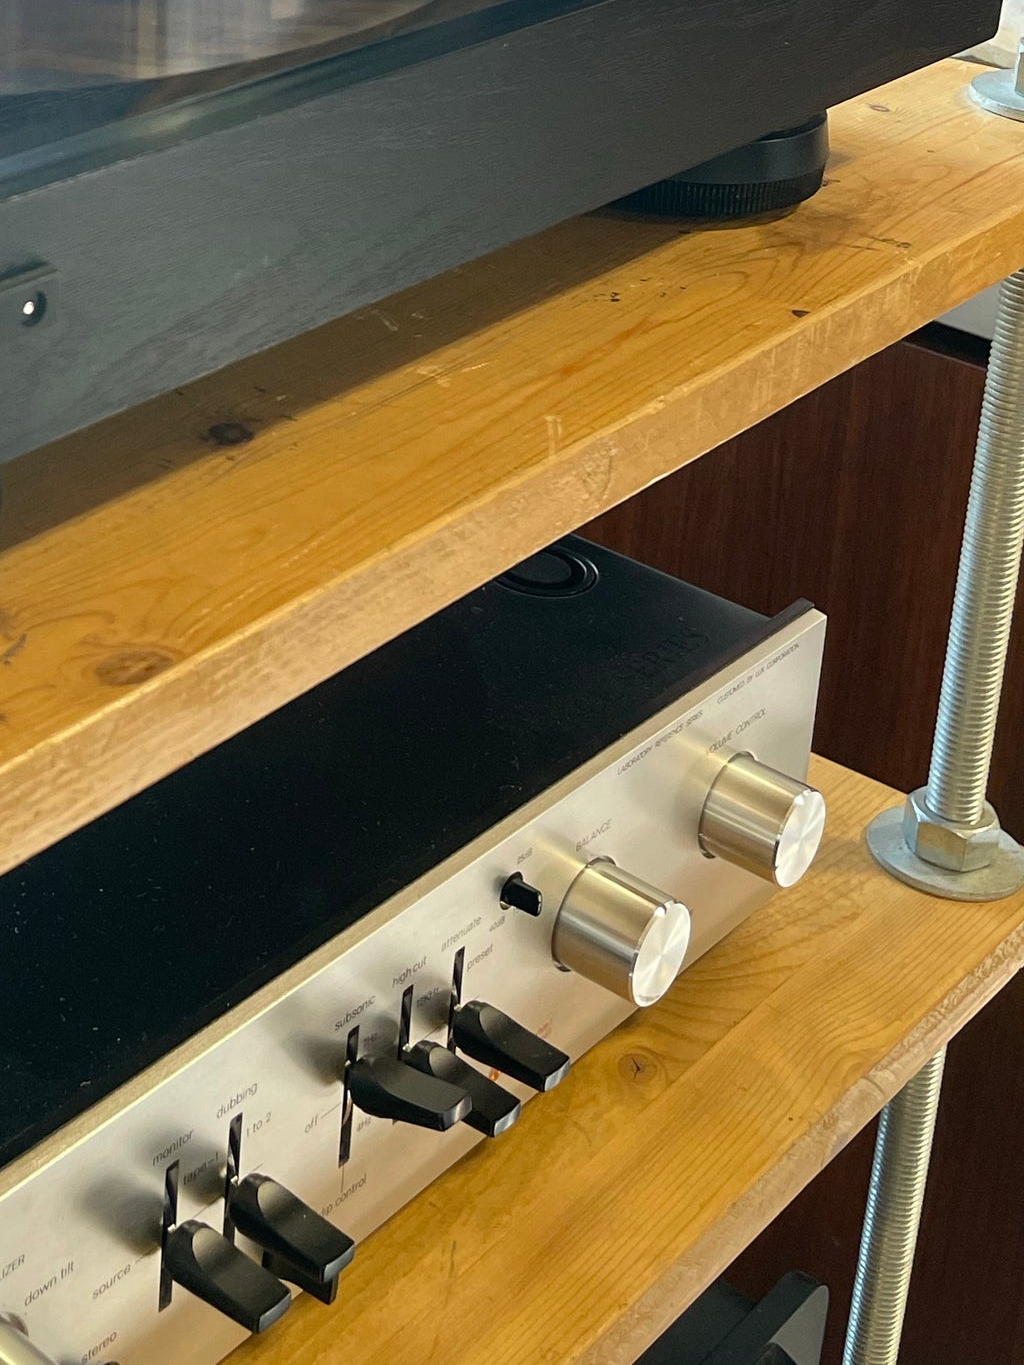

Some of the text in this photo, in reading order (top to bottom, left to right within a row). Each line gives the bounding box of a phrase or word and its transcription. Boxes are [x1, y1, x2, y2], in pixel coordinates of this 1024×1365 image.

[735, 707, 767, 735] CONTROL
[576, 818, 613, 852] BALANCE
[441, 916, 482, 952] attenuate
[392, 956, 427, 988] high cut
[466, 944, 494, 972] preset
[334, 995, 376, 1031] subsonic
[216, 1082, 258, 1119] dubbing
[252, 1118, 263, 1131] to
[265, 1111, 273, 1123] 2
[304, 1114, 318, 1134] off
[152, 1128, 195, 1166] monitor
[335, 1172, 367, 1206] control
[24, 1261, 75, 1307] down tilt
[92, 1263, 132, 1300] source
[81, 1331, 118, 1364] stereo
